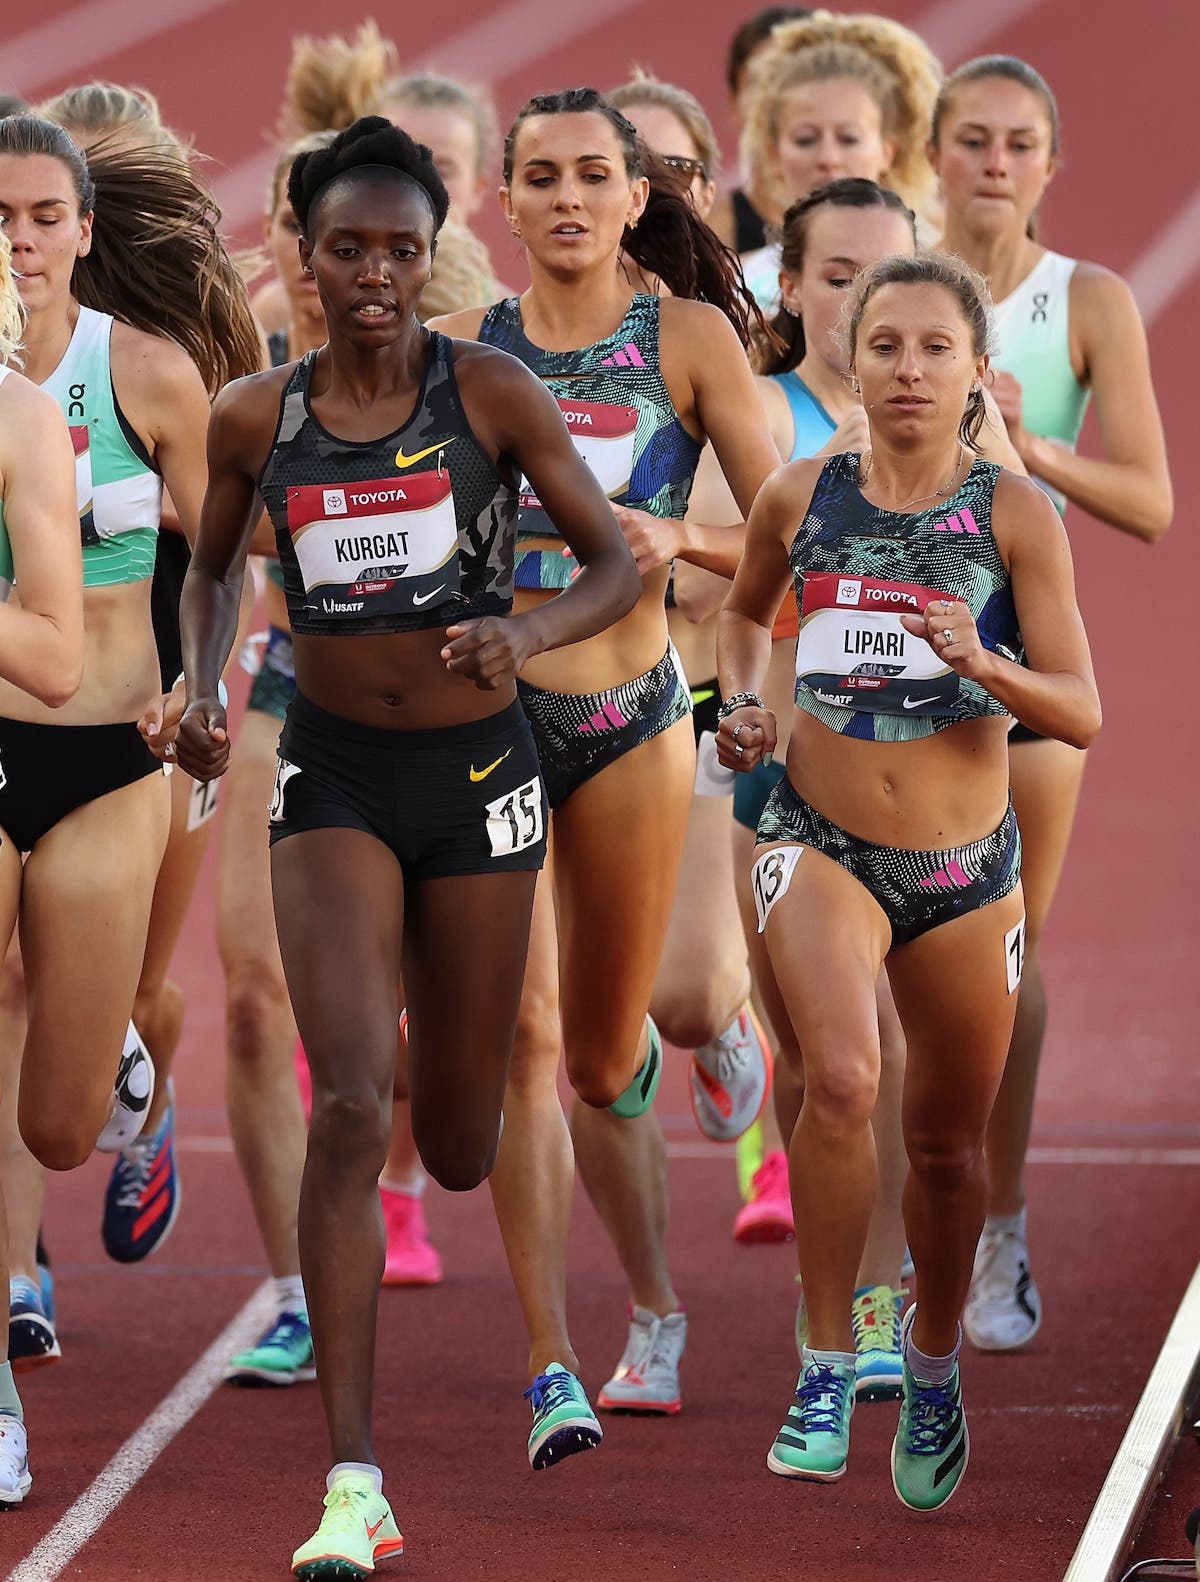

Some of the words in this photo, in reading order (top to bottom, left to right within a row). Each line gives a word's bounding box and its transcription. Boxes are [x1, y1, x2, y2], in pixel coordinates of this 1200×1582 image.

[562, 411, 593, 425] OTA
[350, 489, 407, 506] TOYOTA
[334, 531, 409, 563] KURGAT
[334, 602, 364, 612] USATF
[864, 588, 918, 607] TOYOTA
[844, 629, 905, 657] LIPARI
[499, 784, 537, 850] 15
[754, 852, 785, 918] 13
